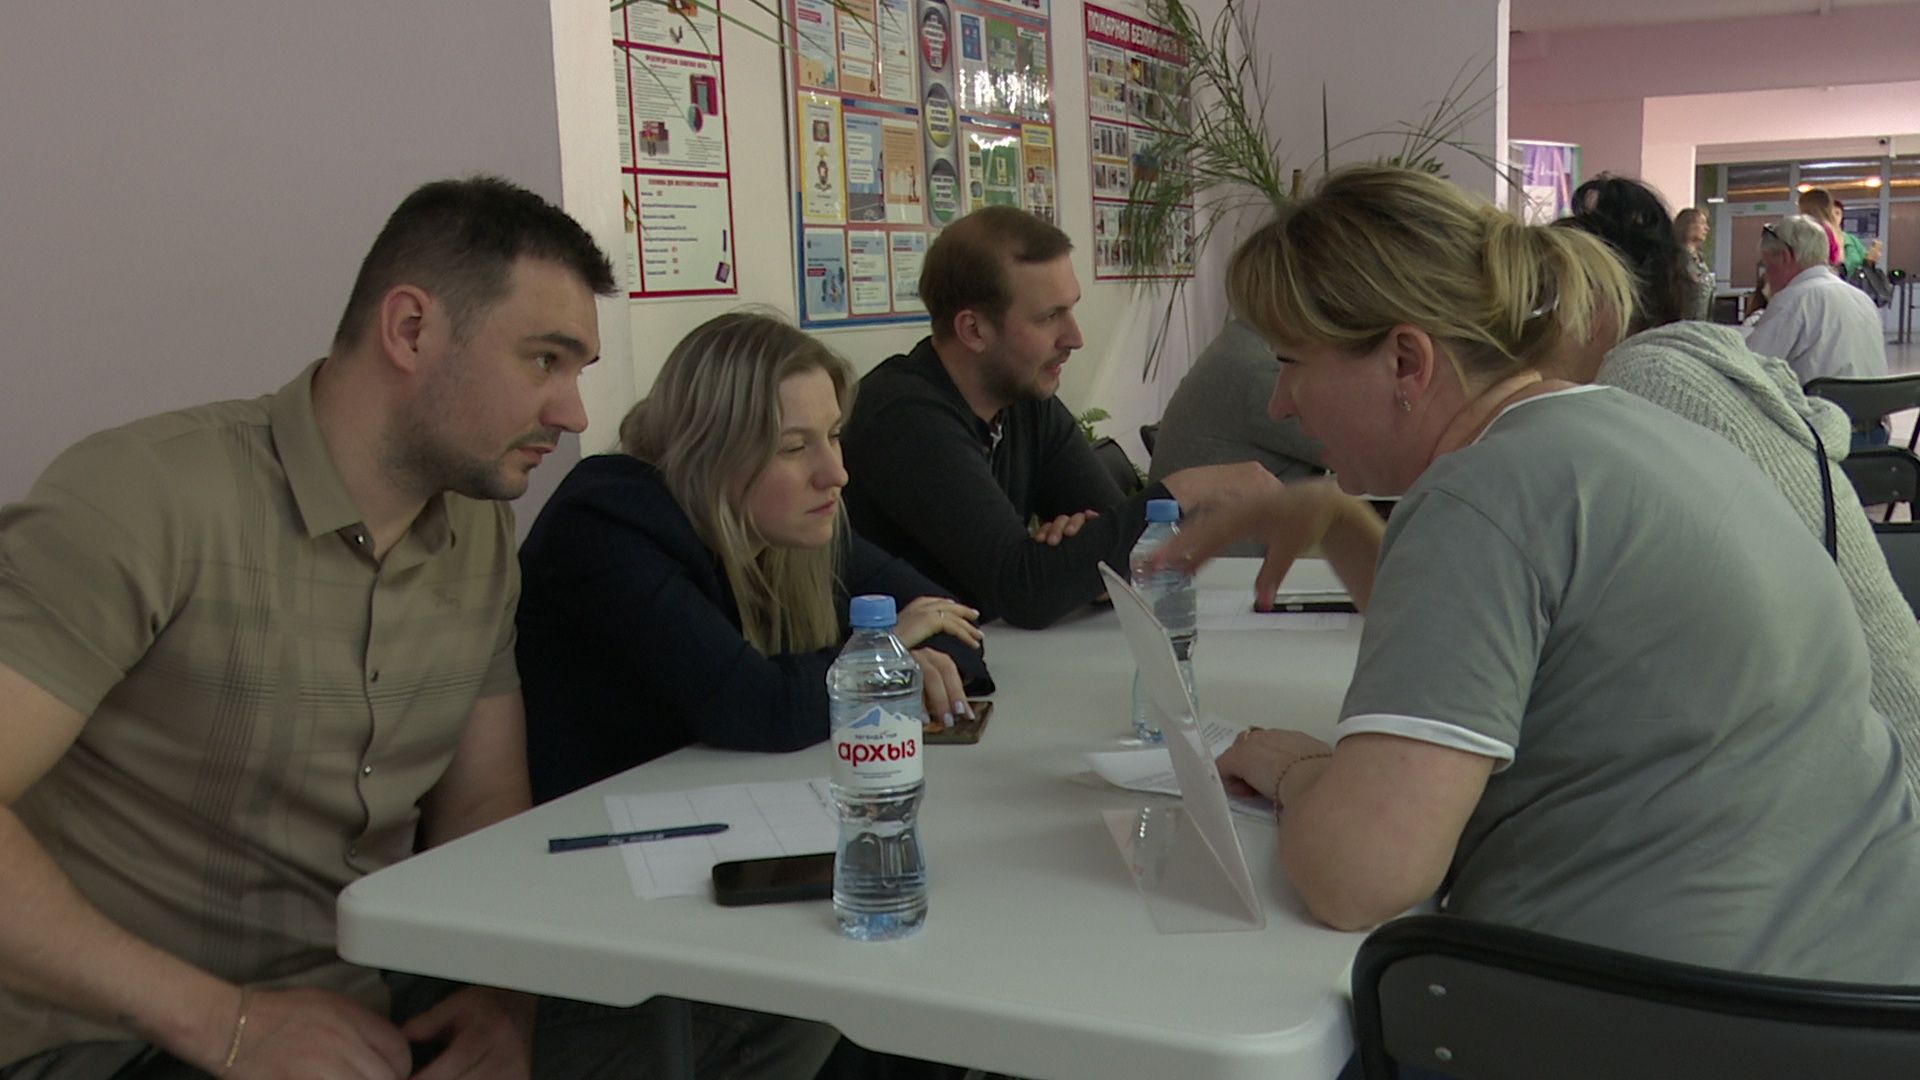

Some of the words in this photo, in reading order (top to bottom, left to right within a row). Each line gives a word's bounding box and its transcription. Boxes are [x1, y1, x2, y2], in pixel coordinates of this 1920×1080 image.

[1087, 9, 1130, 42] ПОЖАРНАЯ
[1131, 23, 1188, 58] БЕЗОПАС
[838, 739, 915, 767] архыз
